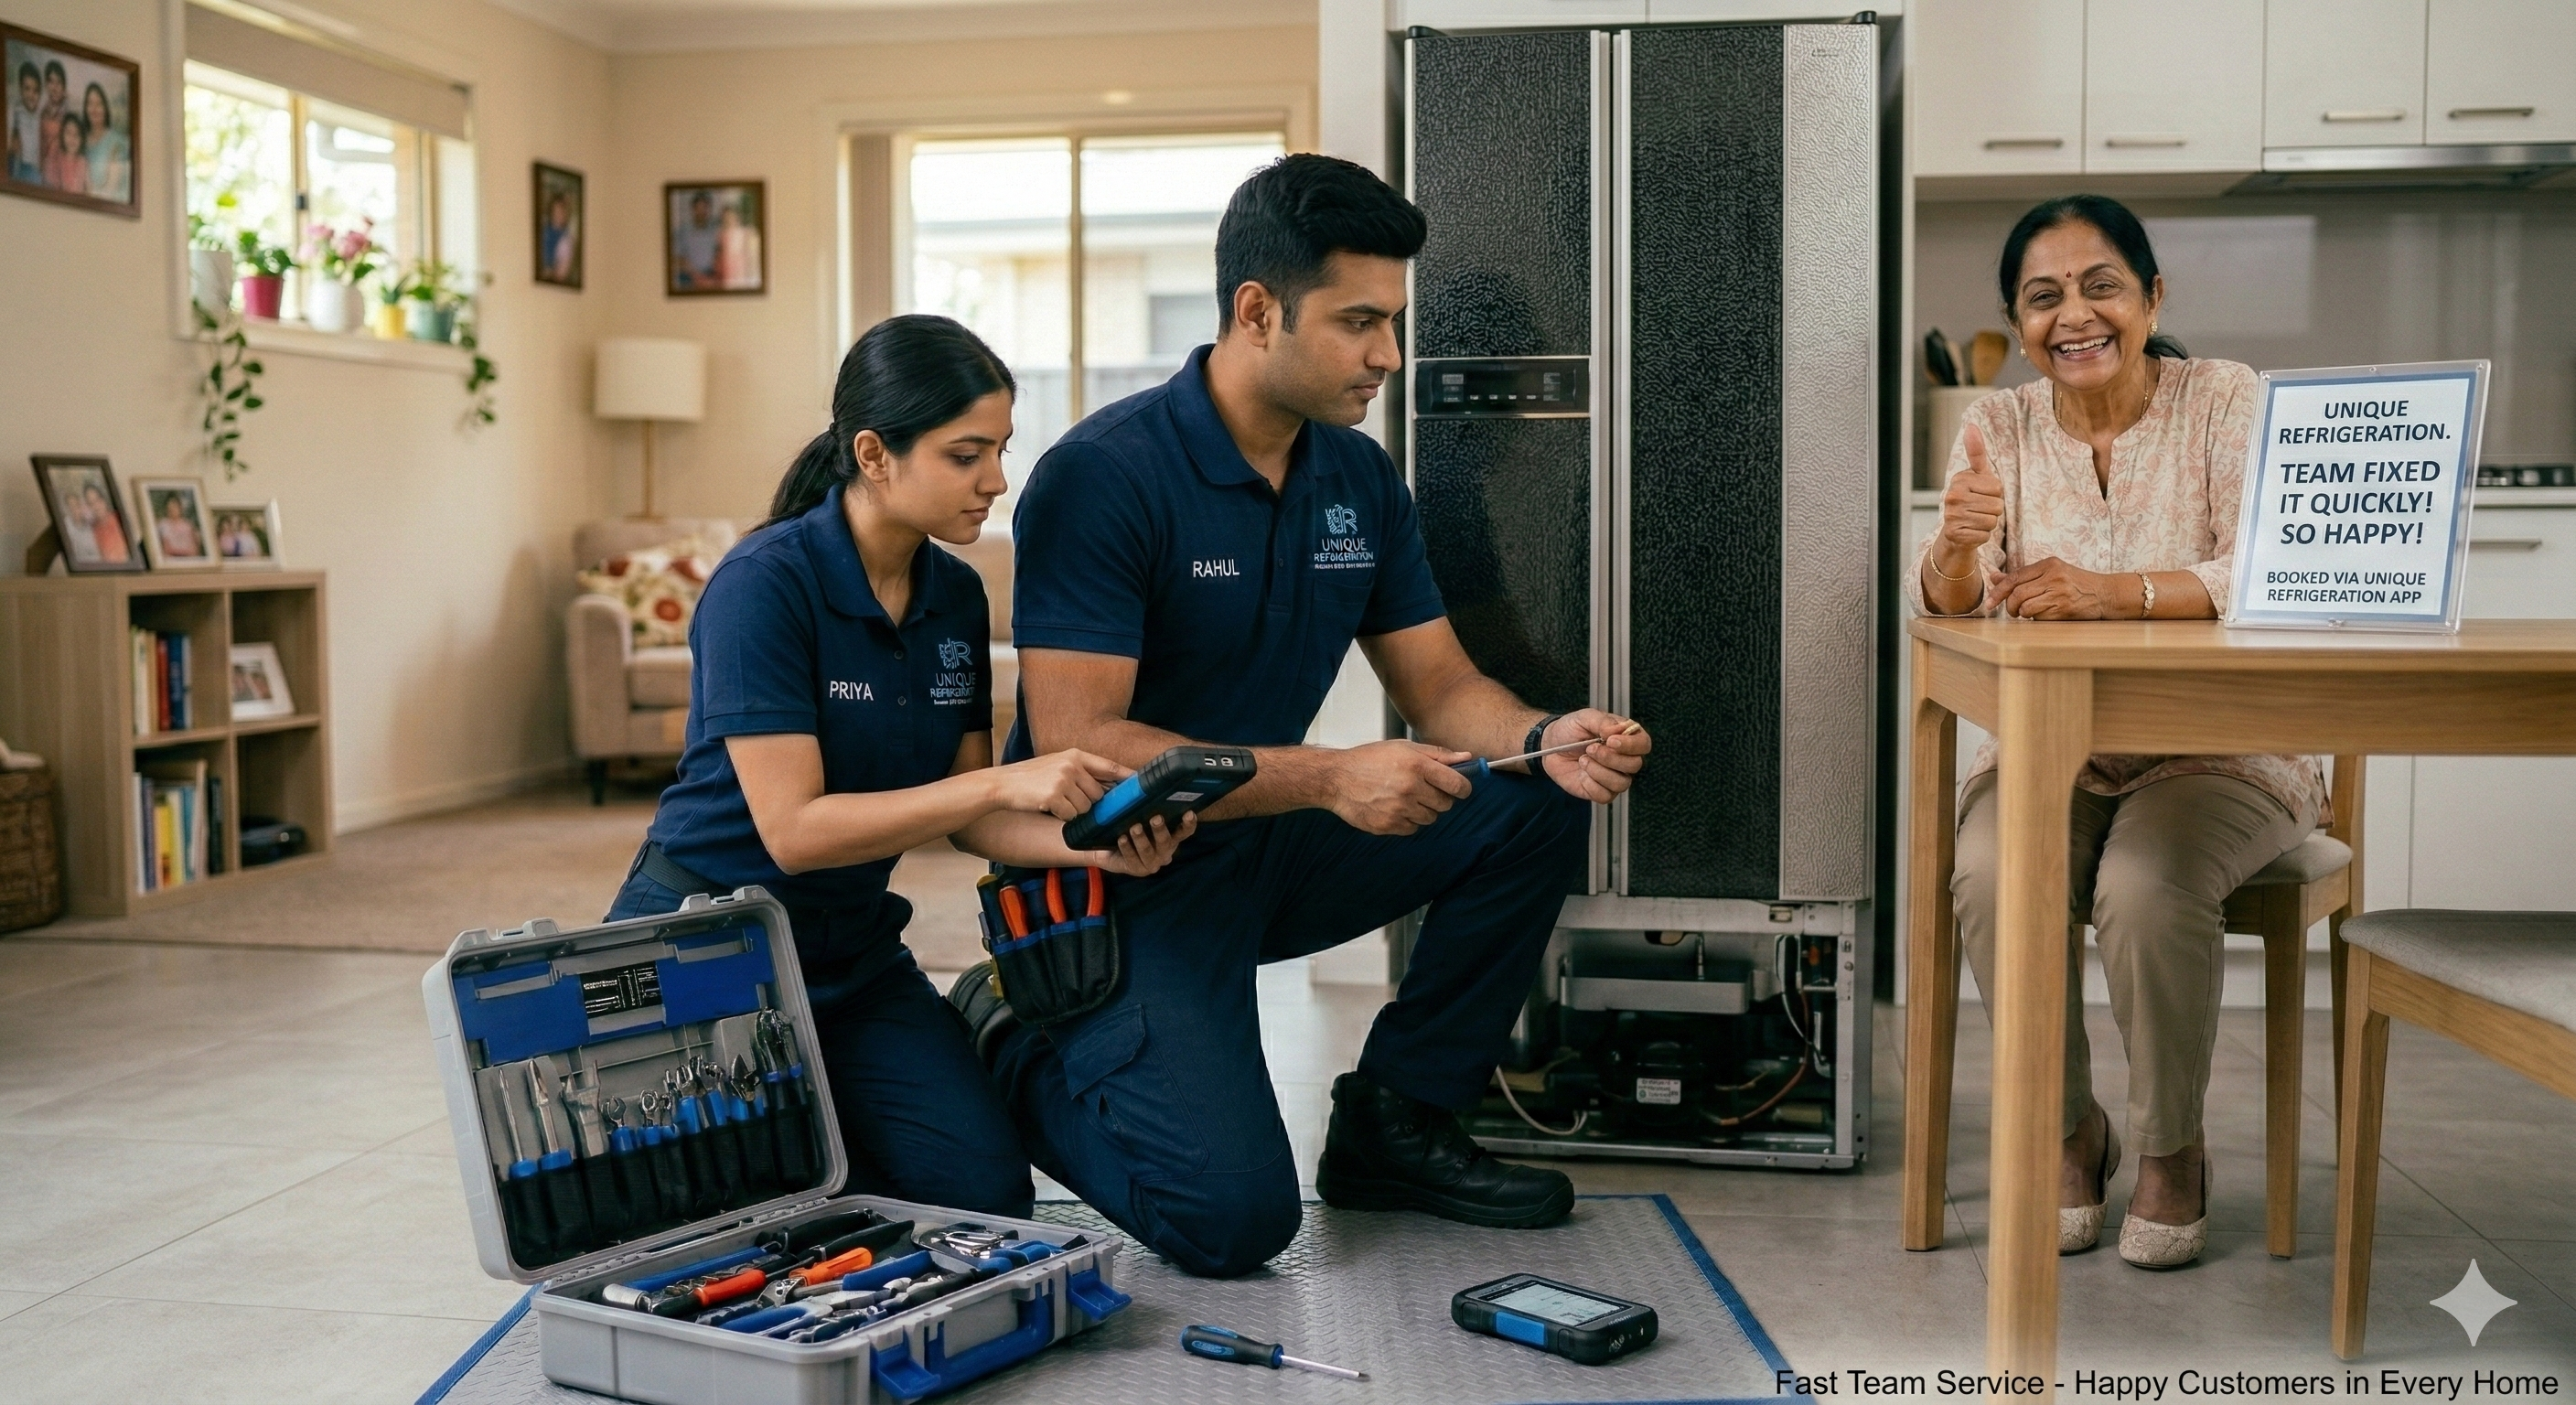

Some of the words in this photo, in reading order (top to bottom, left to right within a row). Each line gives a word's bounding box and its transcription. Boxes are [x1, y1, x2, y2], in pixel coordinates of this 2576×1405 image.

[2324, 400, 2410, 420] UNIQUE
[2279, 423, 2452, 445] REFRIGERATION.
[2281, 462, 2356, 484] TEAM
[2363, 460, 2442, 482] FIXED
[2280, 493, 2304, 514] IT
[2310, 490, 2433, 516] QUICKLY!
[2280, 523, 2316, 545] SO
[2324, 521, 2424, 544] HAPPY!
[1321, 537, 1368, 552] UNIQUE
[1192, 559, 1240, 578] RAHUL
[2267, 572, 2329, 585] BOOKED
[2334, 572, 2360, 585] VIA
[2364, 572, 2427, 585] UNIQUE
[2267, 589, 2386, 604] REFRIGERATION
[2389, 591, 2422, 604] APP
[935, 672, 977, 688] UNIQUE
[829, 681, 875, 701] PRIYA
